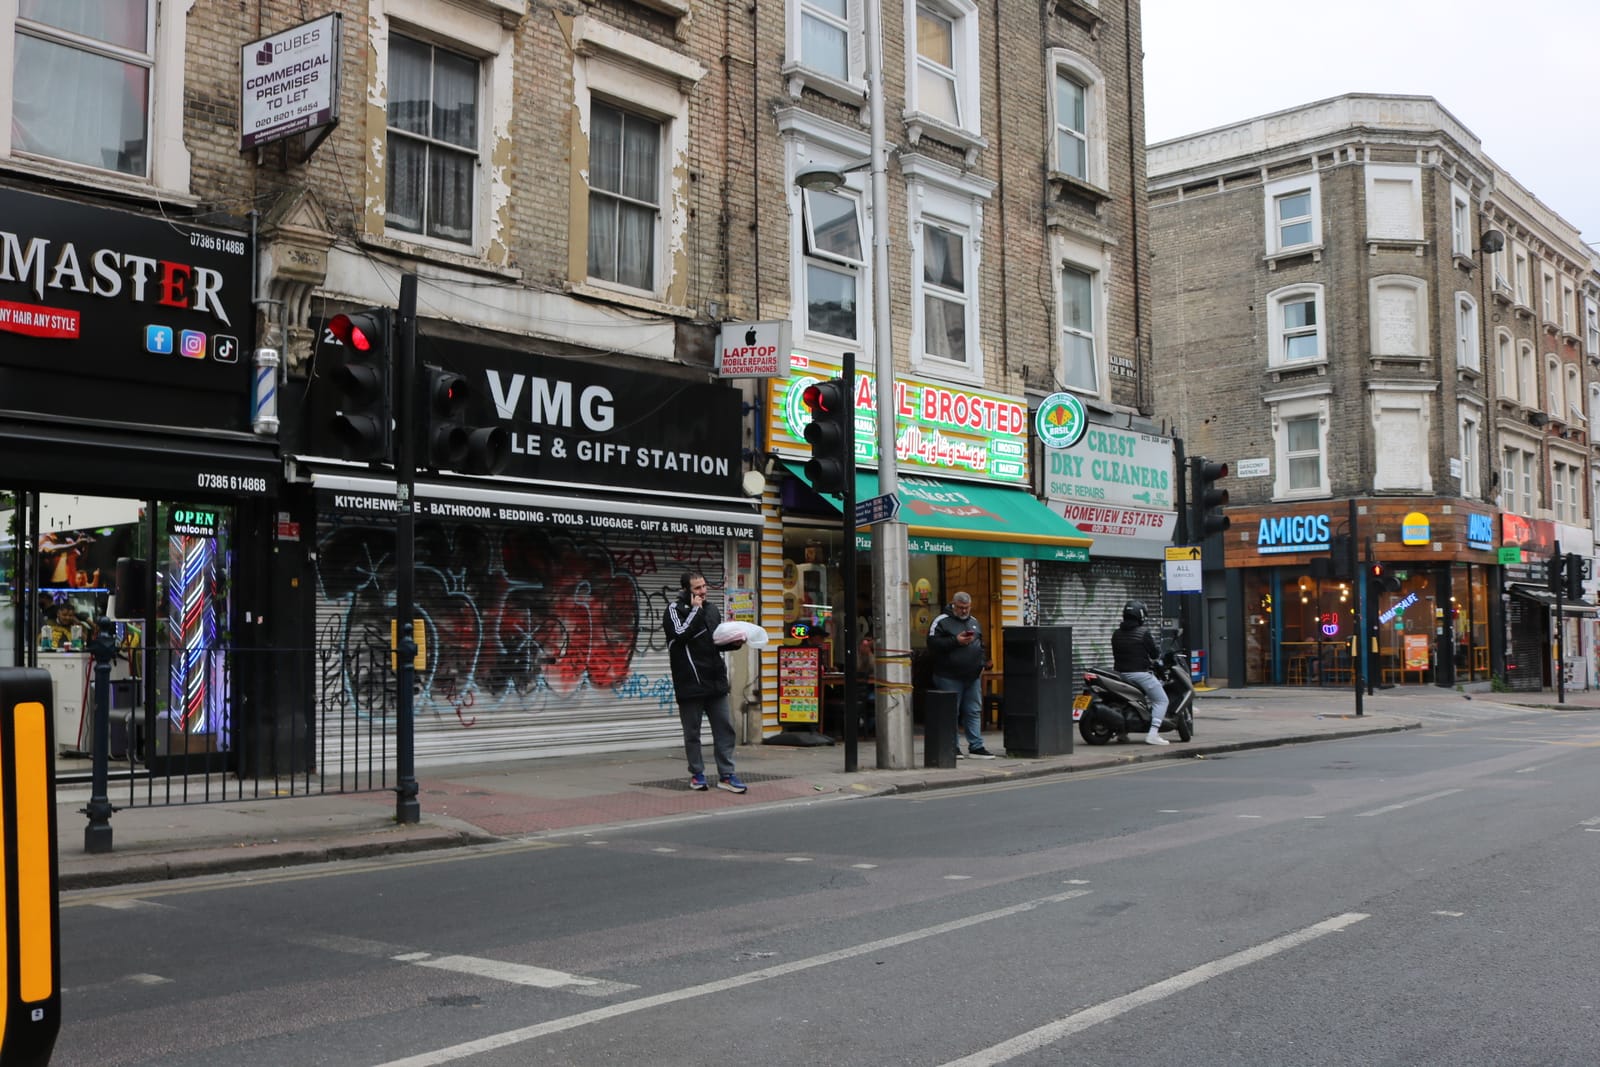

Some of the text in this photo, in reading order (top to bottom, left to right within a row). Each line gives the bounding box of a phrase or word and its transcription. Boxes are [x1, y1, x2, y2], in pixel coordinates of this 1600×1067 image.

[274, 29, 320, 55] CUBES
[246, 53, 329, 90] COMMERCIAL
[256, 70, 319, 100] PREMISES
[267, 88, 309, 111] TO LET
[255, 102, 319, 128] 020 8201 5454
[190, 231, 245, 256] 07385 614868
[0, 231, 231, 327] MASTER
[0, 309, 76, 332] NY HAIR ANY STYLE
[722, 357, 777, 366] MOBILE REPAIRS
[723, 346, 776, 358] LAPTOP
[722, 366, 753, 374] UNLOCKING
[485, 369, 615, 433] VMG
[856, 376, 1023, 434] AIL BROSTED
[510, 432, 729, 477] LE & GIFT STATION
[1087, 430, 1136, 458] CREST
[198, 473, 266, 492] 07385 614868
[1050, 452, 1169, 490] DRY CLEANERS
[1050, 481, 1105, 499] SHOE REPAIRS
[174, 510, 215, 526] OPEN
[174, 523, 214, 535] welcome
[335, 495, 421, 514] KITCHENWE
[430, 503, 491, 519] BATHROOM
[499, 508, 544, 523] BEDDING
[552, 512, 584, 526] TOOLS
[590, 515, 633, 530] LUGGAGE
[640, 520, 659, 532] GIFT
[661, 521, 669, 533] &
[670, 521, 689, 534] RUG
[694, 524, 725, 537] MOBILE
[726, 526, 733, 537] &
[733, 526, 754, 539] VAPE
[1064, 504, 1164, 528] HOMEVIEW ESTATES
[1467, 513, 1493, 542] AMIGOS
[1257, 514, 1331, 545] AMIGOS
[924, 541, 954, 552] Pastries
